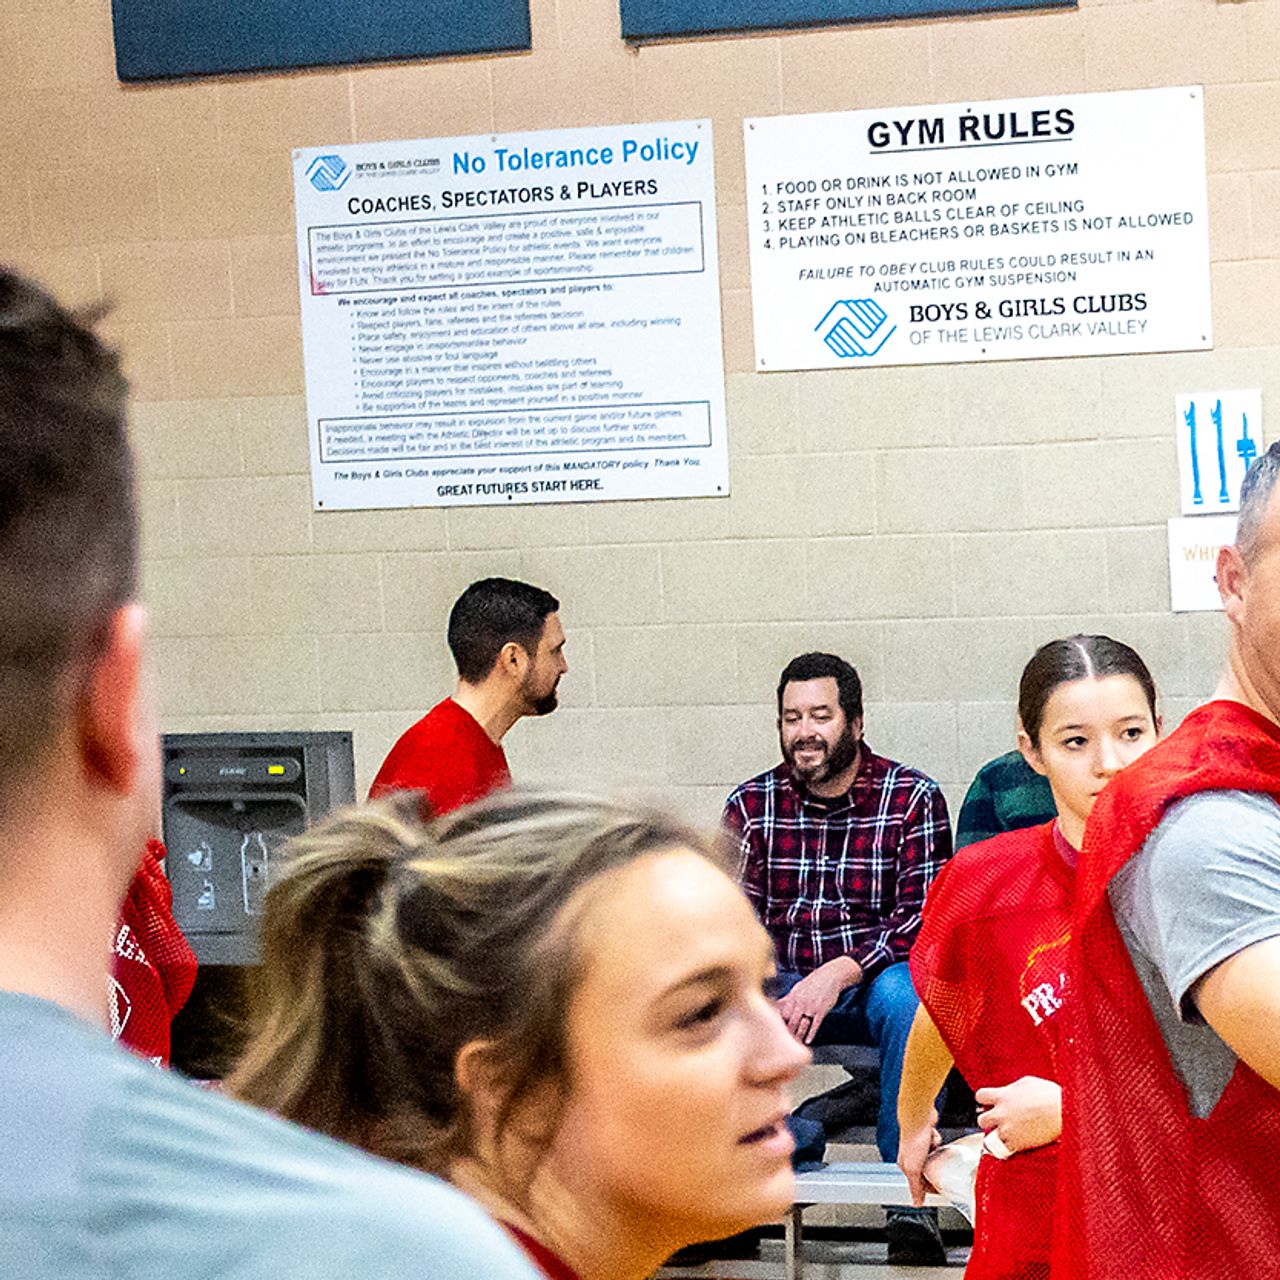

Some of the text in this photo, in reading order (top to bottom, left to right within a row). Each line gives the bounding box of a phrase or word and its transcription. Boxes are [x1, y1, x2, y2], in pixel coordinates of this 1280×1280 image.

[867, 108, 1073, 148] GYM RULES
[452, 135, 698, 175] No Tolerance Policy
[776, 180, 816, 195] FOOD
[821, 178, 841, 191] OR
[846, 175, 890, 189] DRINK
[895, 173, 908, 187] IS
[913, 171, 942, 185] NOT
[948, 166, 1021, 183] ALLOWED
[1025, 165, 1039, 177] IN
[1045, 162, 1078, 176] GYM
[347, 177, 657, 215] COACHES, SPECTATORS & PLAYERS
[777, 198, 820, 212] STAFF
[826, 195, 862, 209] ONLY
[867, 194, 881, 206] IN
[886, 191, 926, 205] BACK
[931, 187, 976, 202] ROOM
[778, 216, 815, 231] KEEP
[821, 211, 888, 228] ATHLETIC
[893, 208, 941, 224] BALLS
[946, 205, 995, 220] CLEAR
[1000, 203, 1018, 216] OF
[1024, 199, 1084, 215] CEILING
[779, 233, 840, 249] PLAYING
[844, 232, 865, 245] ON
[870, 226, 958, 243] BLEACHERS
[963, 224, 984, 237] OR
[989, 219, 1059, 236] BASKETS
[1064, 218, 1076, 231] IS
[1082, 216, 1111, 230] NOT
[1118, 211, 1193, 228] ALLOWED
[798, 249, 1153, 280] FAILURE TO OBEY CLUB RULES COULD RESULT IN AN
[873, 270, 1076, 292] AUTOMATIC GYM SUSPENSION
[910, 292, 1146, 322] BOYS & GIRLS CLUBS
[909, 318, 1147, 345] OF THE LEWIS CLARK VALLEY
[436, 479, 602, 496] GREAT FUTURES START HERE.
